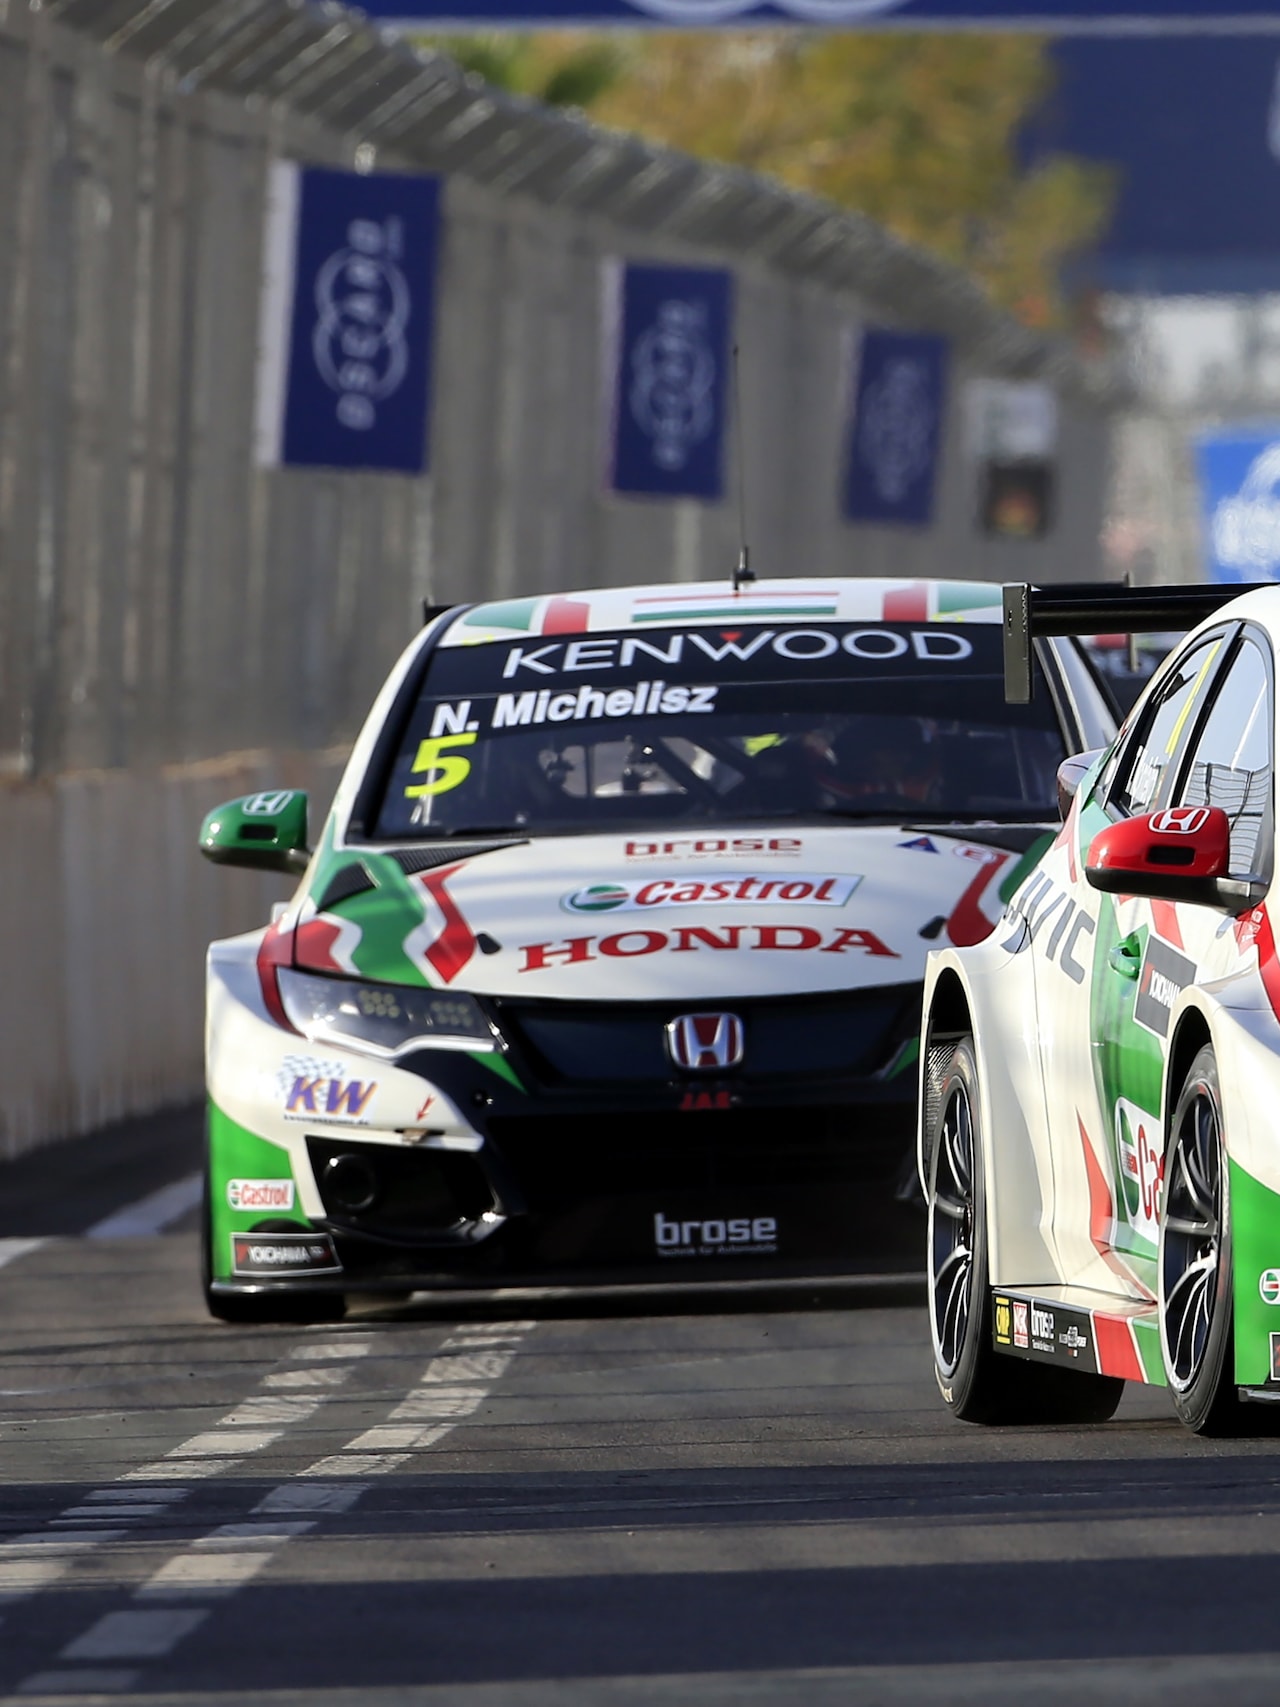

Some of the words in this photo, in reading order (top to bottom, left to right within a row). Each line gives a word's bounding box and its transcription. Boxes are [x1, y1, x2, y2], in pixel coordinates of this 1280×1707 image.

[503, 629, 974, 679] KENWOOD
[430, 700, 480, 738] N.
[492, 680, 719, 729] Michelisz
[403, 731, 477, 800] 5
[625, 838, 802, 856] brose
[633, 877, 838, 906] Castrol
[518, 924, 902, 973] HONDA
[285, 1075, 378, 1117] KW
[654, 1212, 777, 1245] brose
